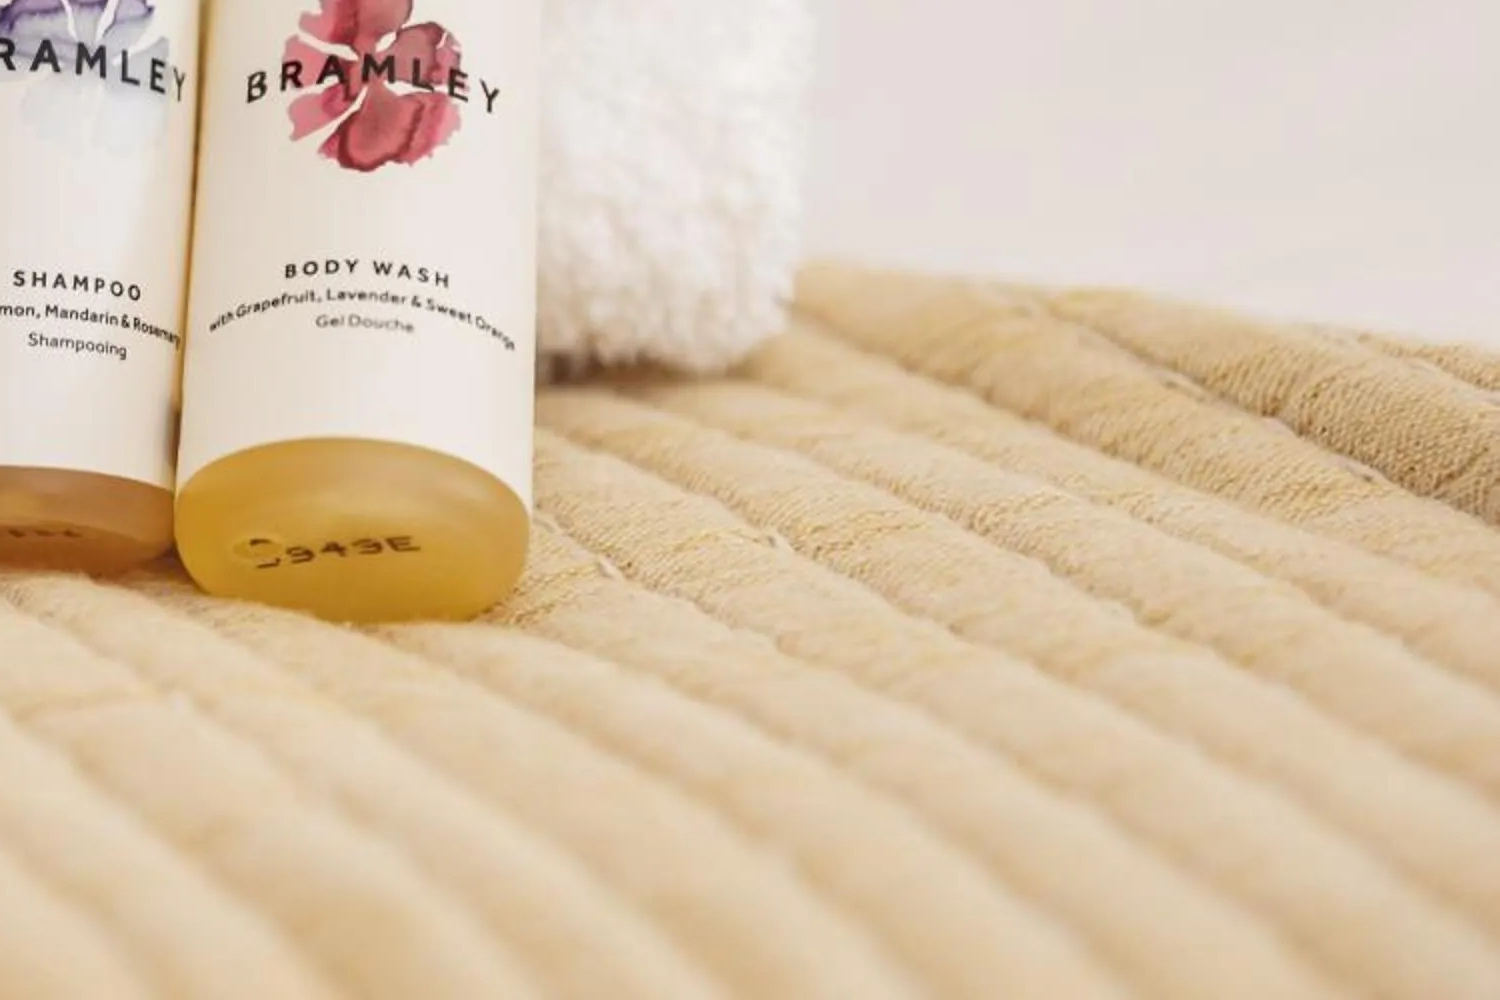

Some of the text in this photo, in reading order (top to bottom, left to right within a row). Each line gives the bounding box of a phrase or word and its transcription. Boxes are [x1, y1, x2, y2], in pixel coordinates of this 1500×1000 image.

[245, 53, 500, 113] BRAMLEY
[12, 269, 141, 301] SHAMPOO
[284, 259, 449, 288] BODY WASH
[45, 304, 119, 326] Mandarin
[121, 314, 131, 329] &
[236, 289, 322, 318] Grapefruit,
[326, 288, 407, 305] Lavender
[411, 295, 421, 308] &
[426, 298, 472, 324] Sweet
[315, 313, 414, 333] Gel Douche
[28, 332, 127, 360] Shampooing
